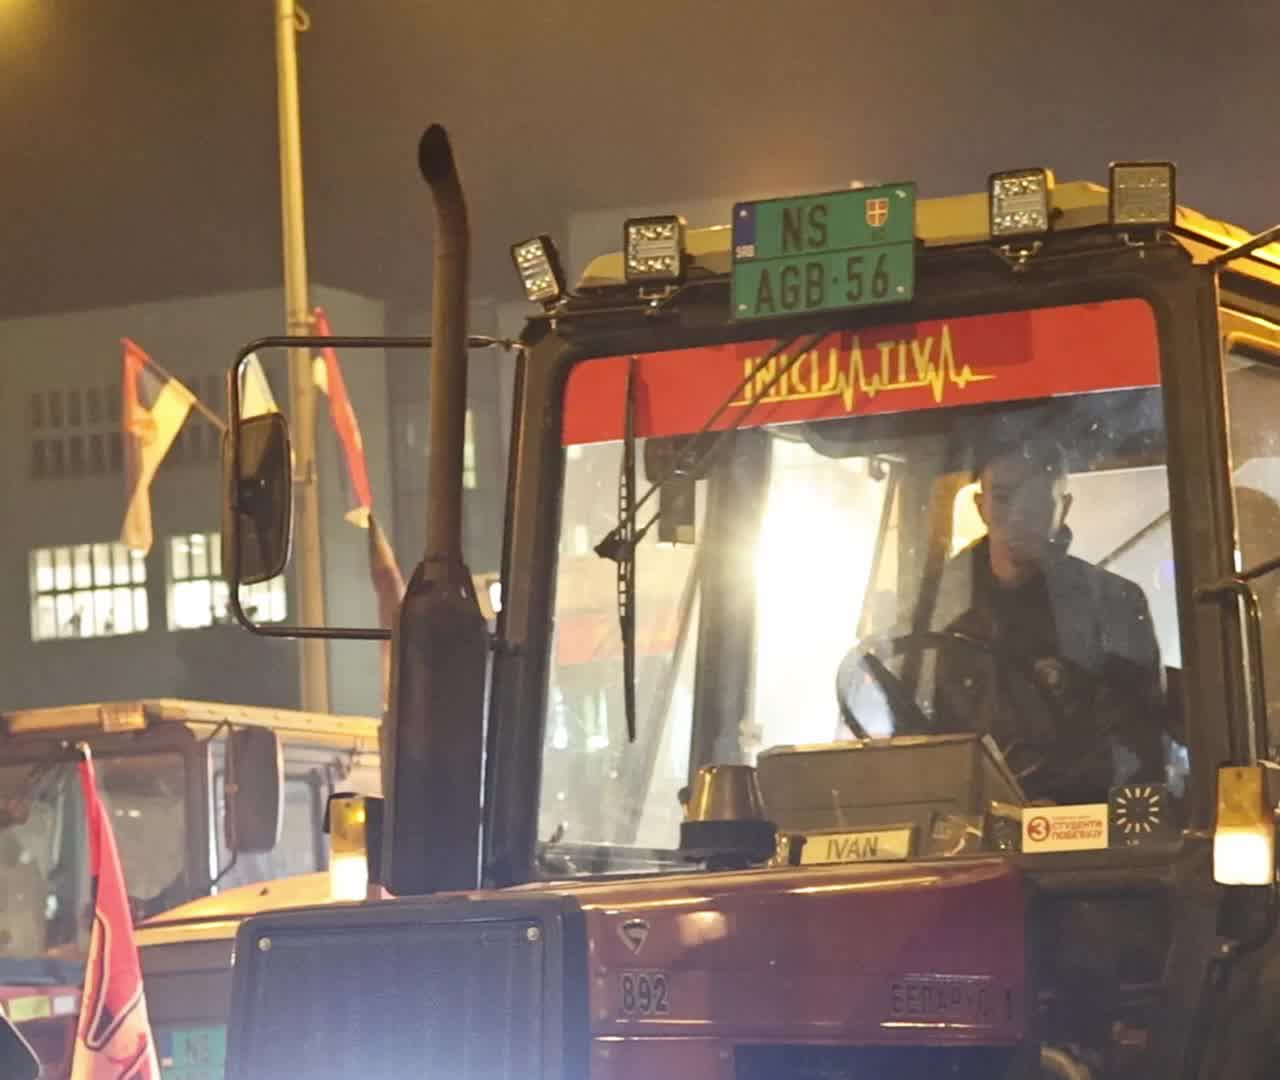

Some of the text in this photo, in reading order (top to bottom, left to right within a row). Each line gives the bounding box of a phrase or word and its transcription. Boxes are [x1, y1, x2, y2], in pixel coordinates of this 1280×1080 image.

[781, 204, 827, 251] NS
[1029, 817, 1049, 841] 3
[825, 835, 879, 860] IVAN
[622, 975, 668, 1012] 892
